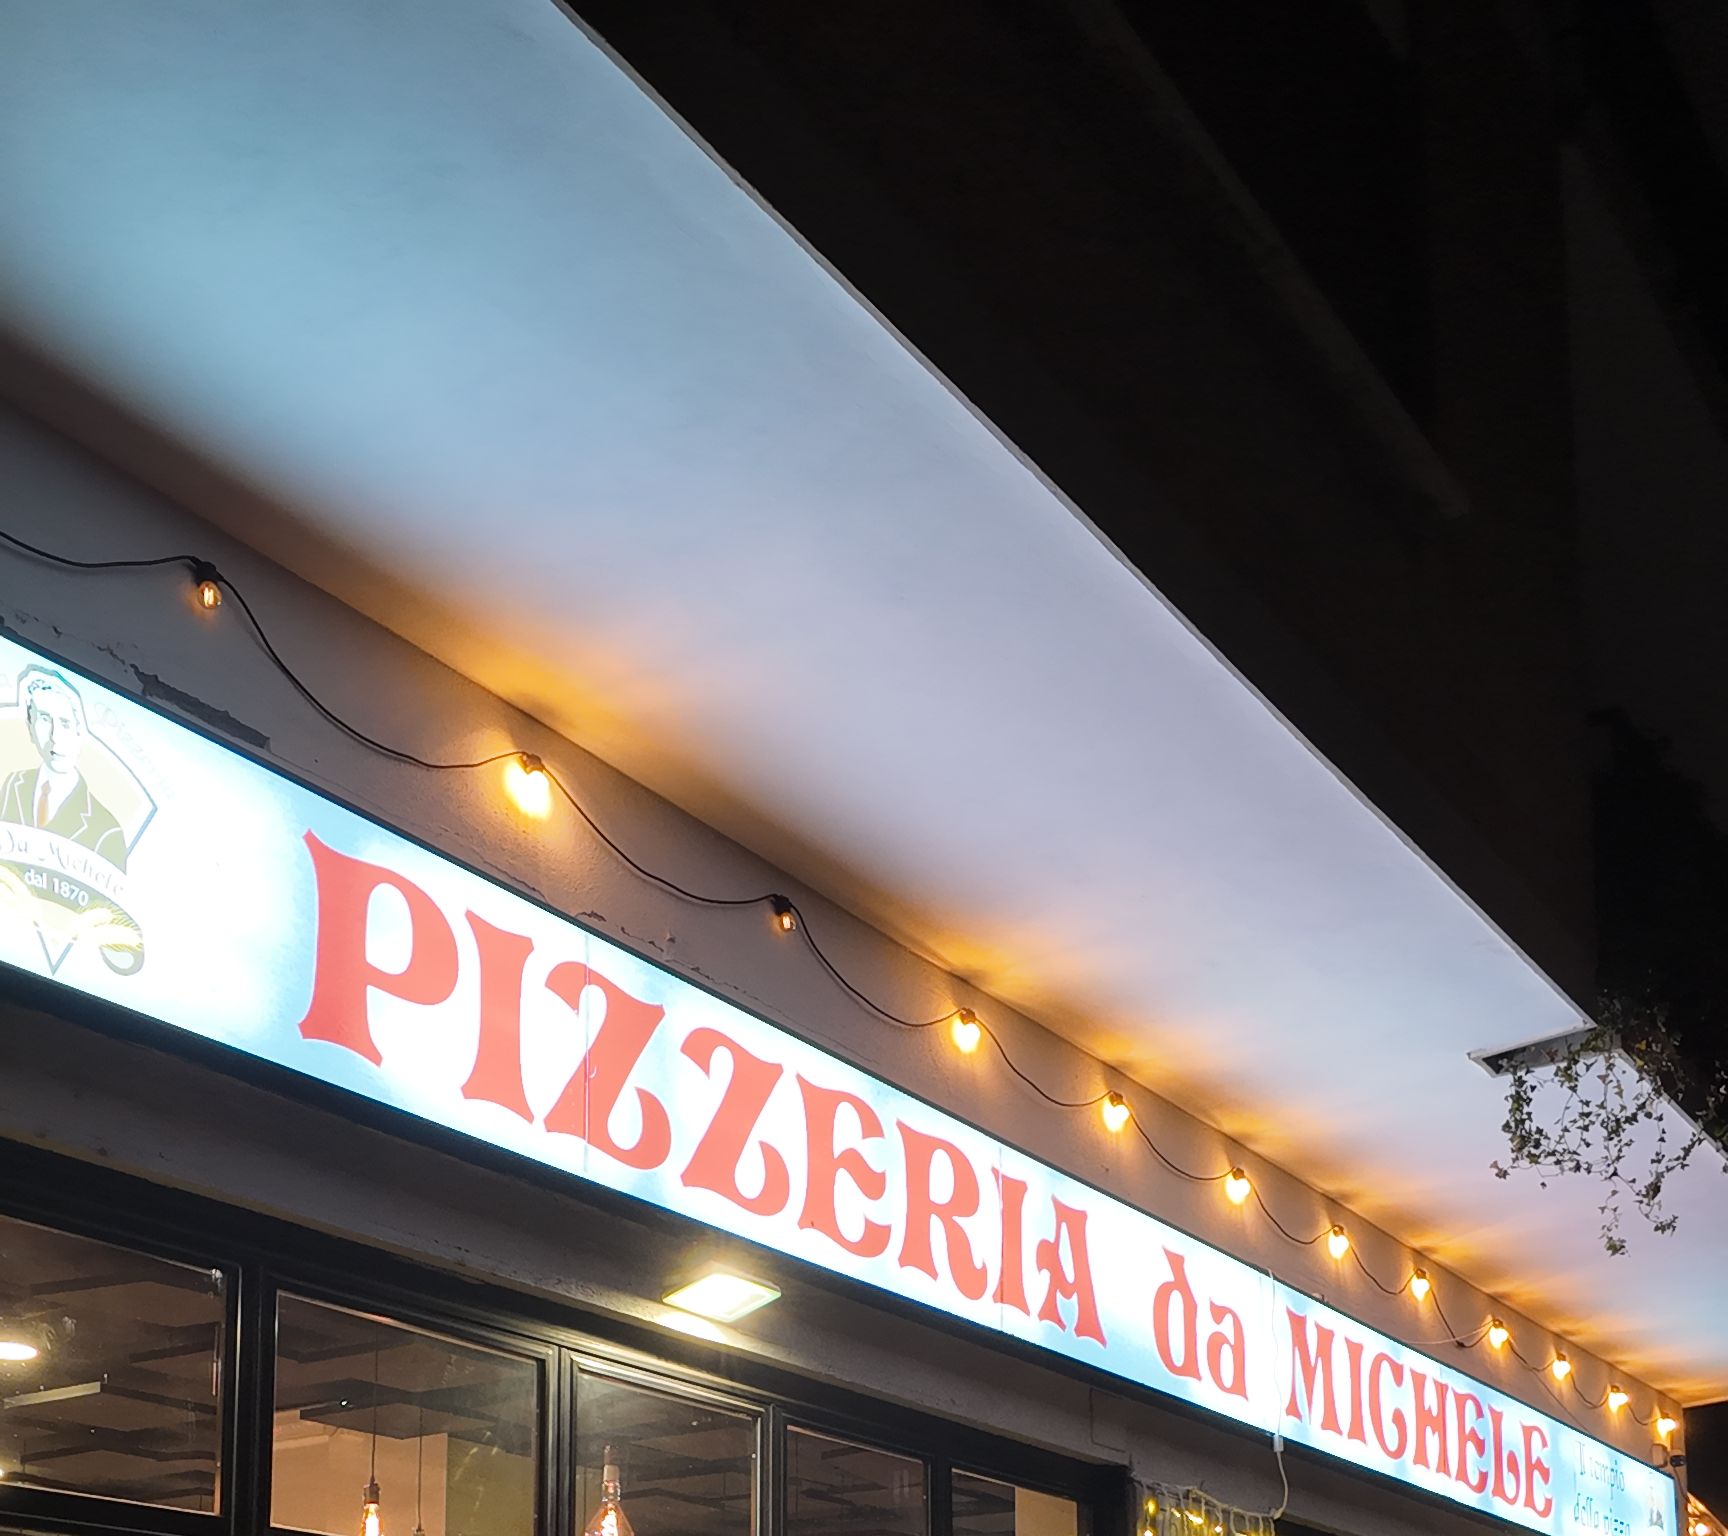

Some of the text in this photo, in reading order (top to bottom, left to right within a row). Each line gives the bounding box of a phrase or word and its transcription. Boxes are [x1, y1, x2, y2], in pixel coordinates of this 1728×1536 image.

[23, 868, 89, 908] dal 1870
[38, 840, 126, 897] Michele
[298, 829, 1553, 1519] PIZZERIA da MICHELE
